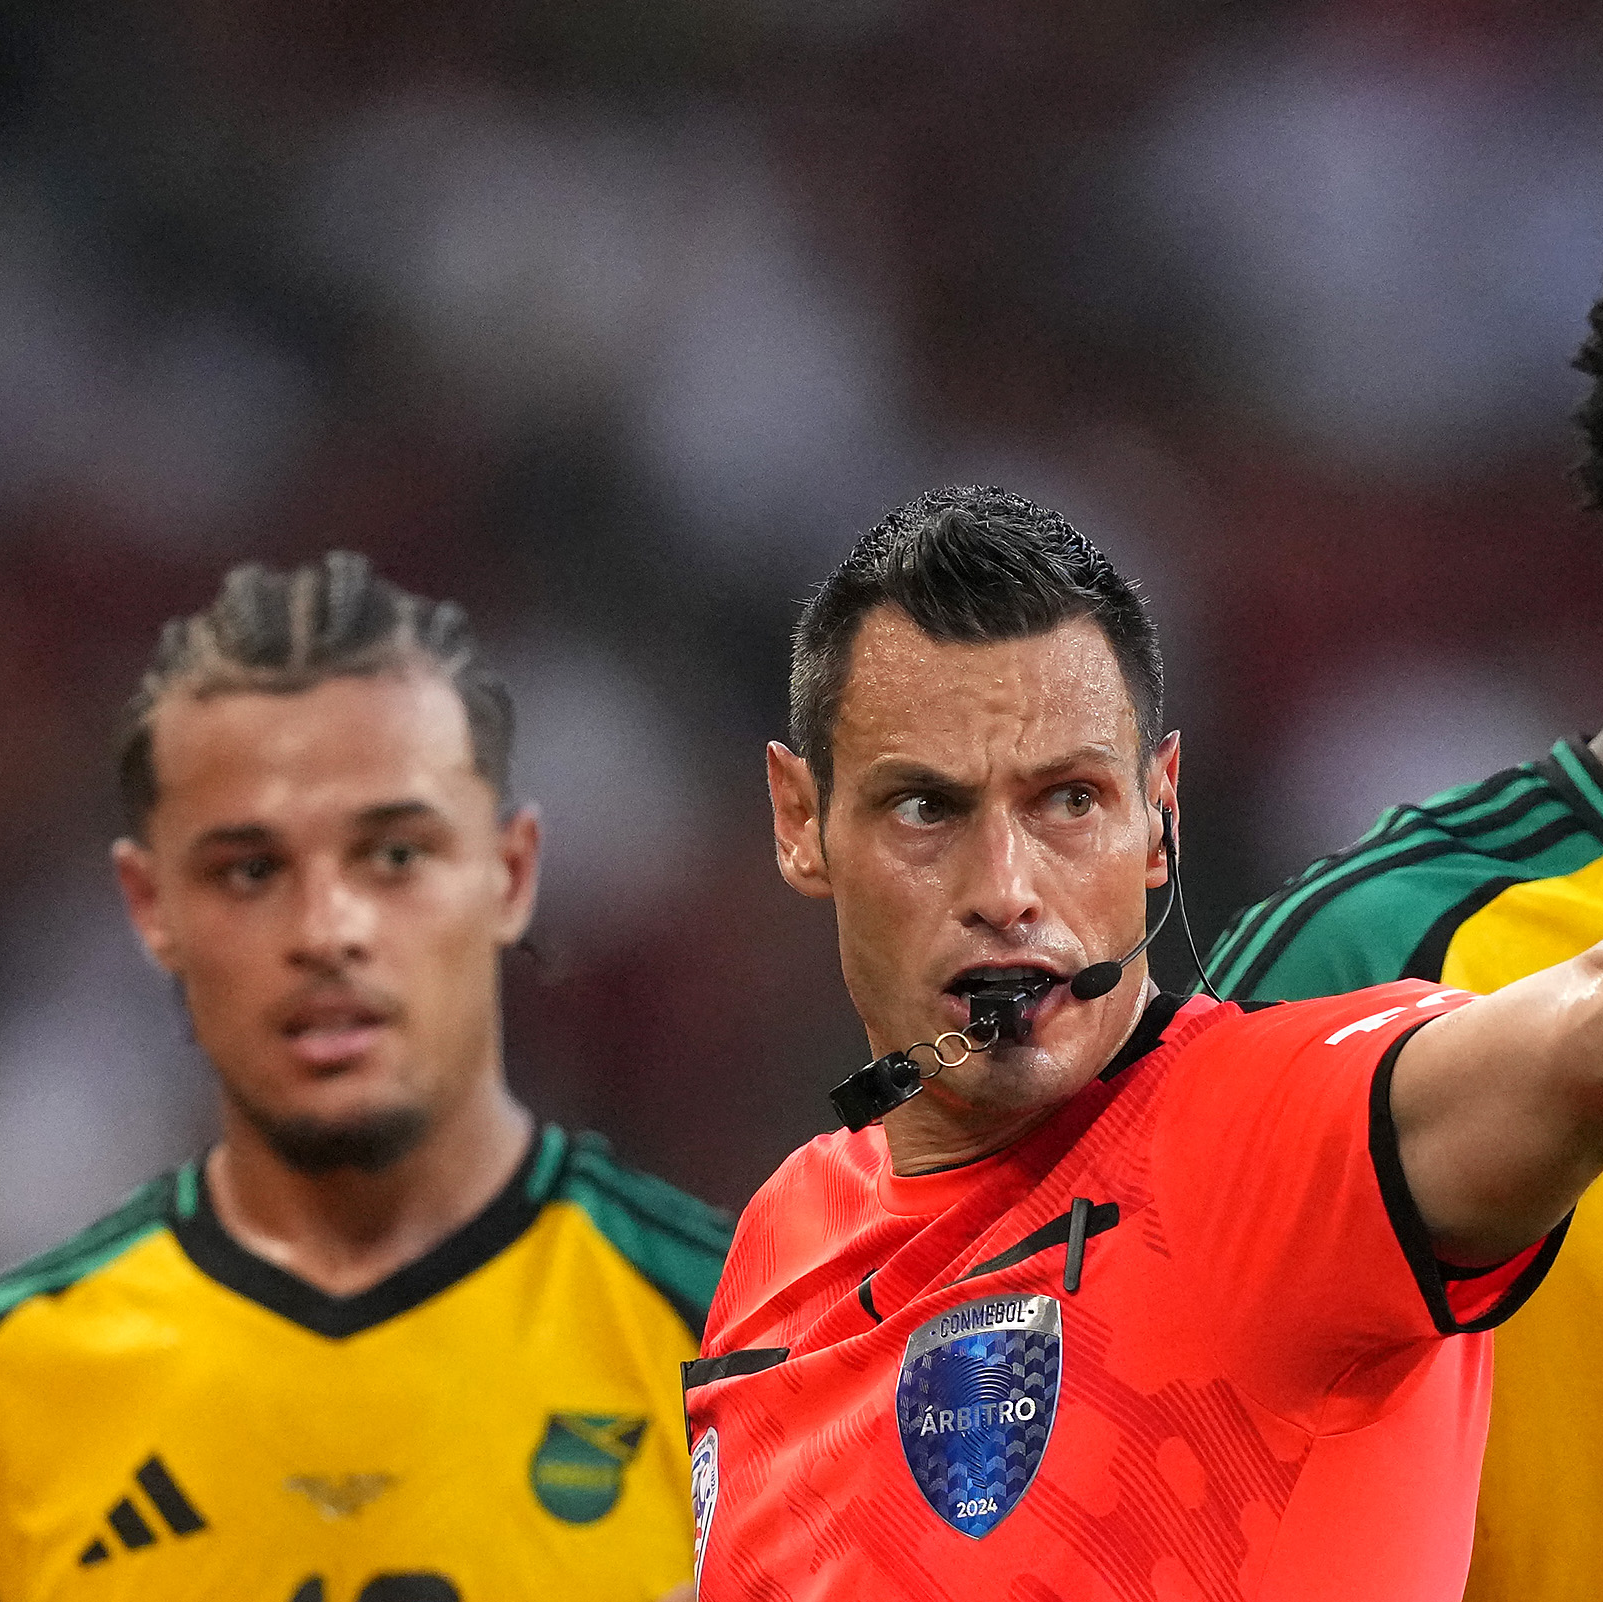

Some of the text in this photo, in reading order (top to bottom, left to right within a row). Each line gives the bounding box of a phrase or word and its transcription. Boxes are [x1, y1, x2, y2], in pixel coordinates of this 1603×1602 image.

[939, 1300, 1027, 1340] CONMEBOL
[919, 1396, 1037, 1438] ÁRBITRO
[955, 1496, 999, 1519] 2024
